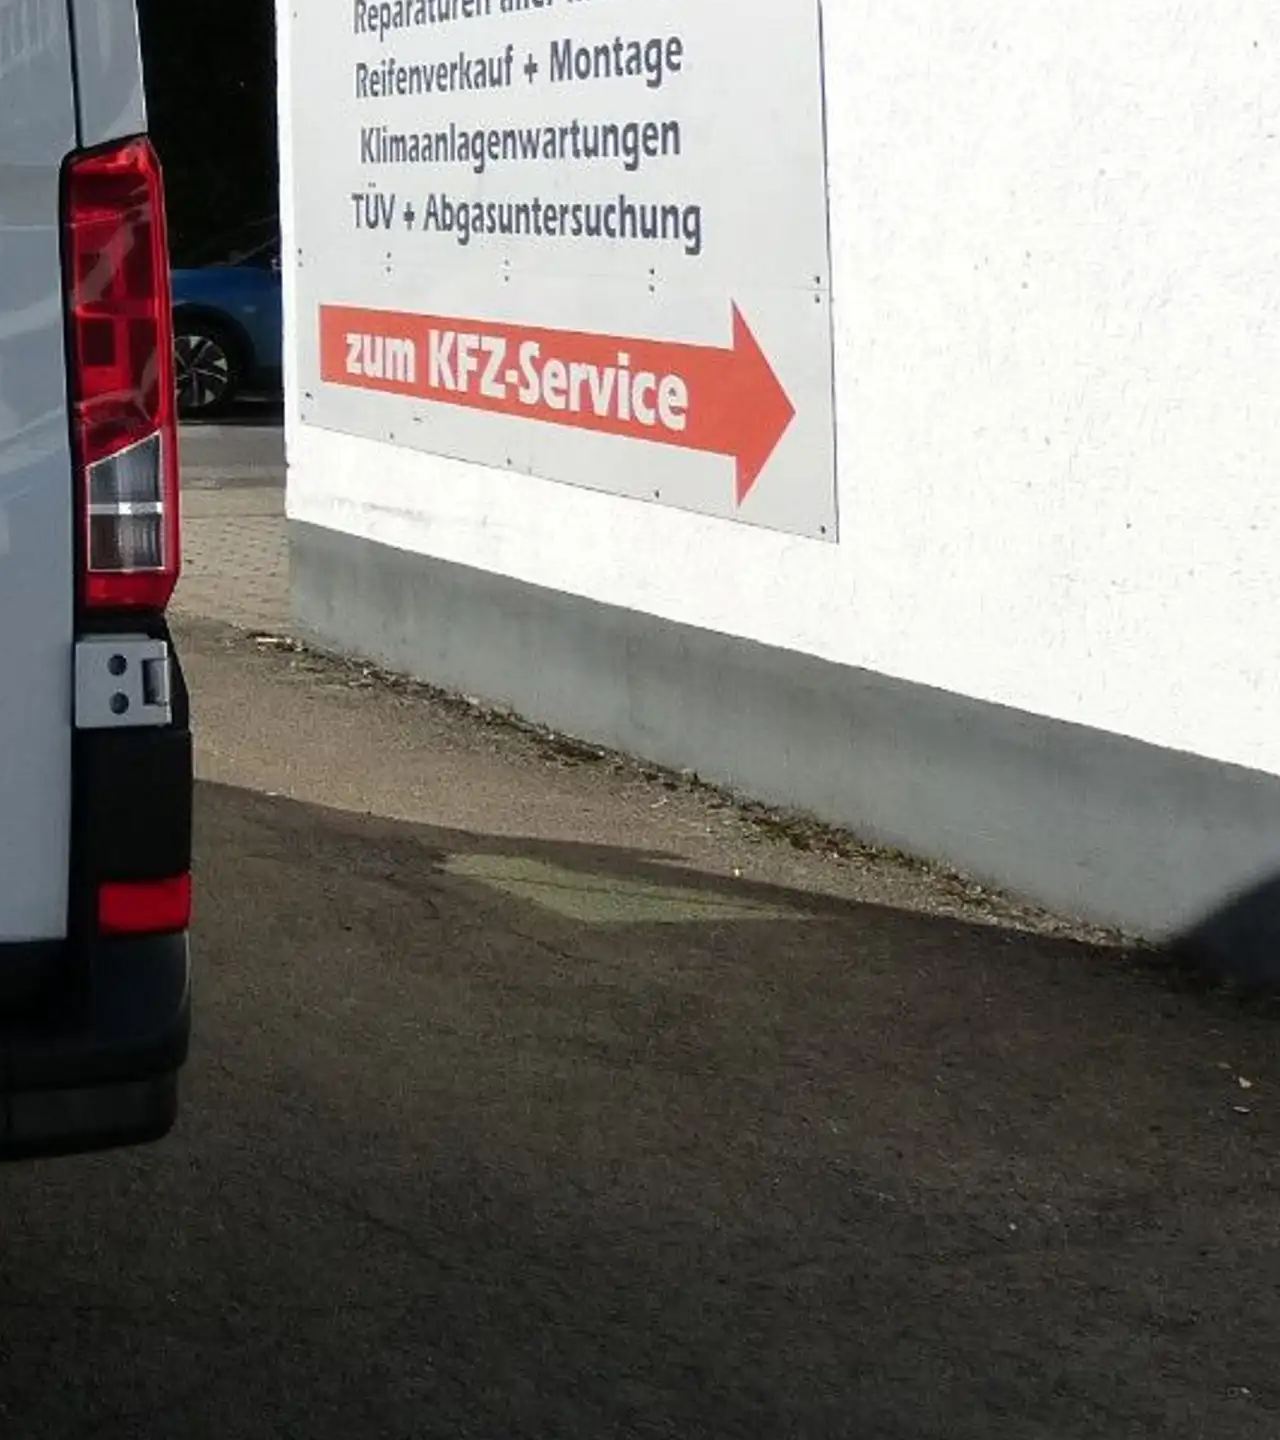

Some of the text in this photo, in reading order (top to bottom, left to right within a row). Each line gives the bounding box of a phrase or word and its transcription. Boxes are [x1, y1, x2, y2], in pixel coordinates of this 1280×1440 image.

[355, 44, 514, 99] Reifenverkauf
[549, 34, 684, 89] Montage
[360, 118, 681, 175] Klimaanlagenwartungen
[351, 182, 395, 231] TÜV
[422, 189, 703, 256] Abgasuntersuchung
[345, 328, 689, 433] zum KFZ-Service
